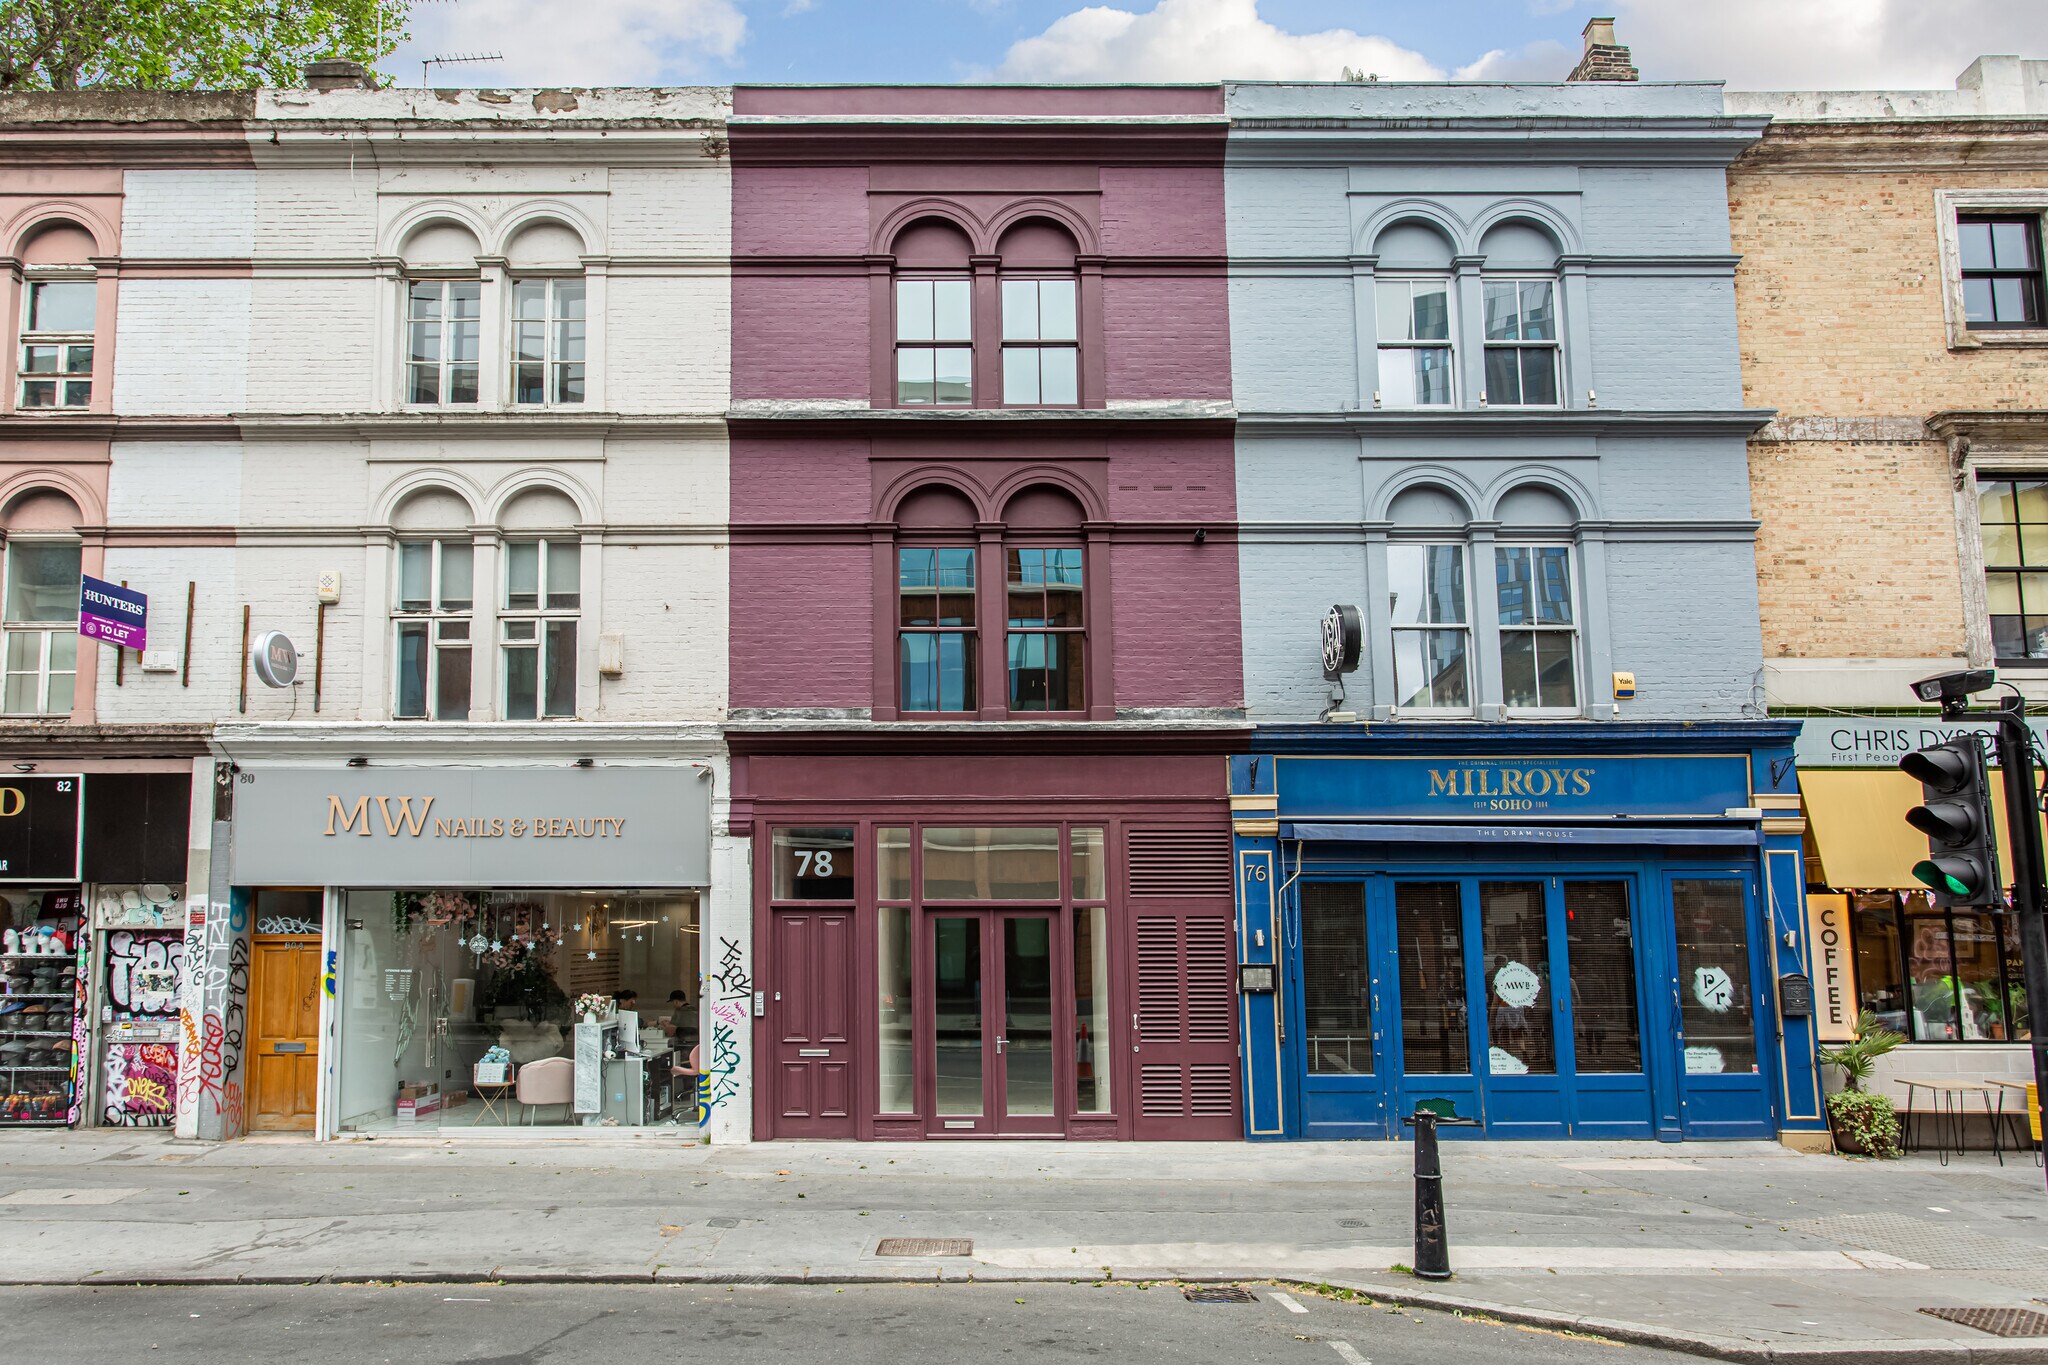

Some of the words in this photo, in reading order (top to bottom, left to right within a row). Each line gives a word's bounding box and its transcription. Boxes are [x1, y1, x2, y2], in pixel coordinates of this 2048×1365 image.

[84, 589, 144, 616] HUNTERS
[100, 624, 112, 634] TO
[114, 628, 129, 639] LET
[1831, 730, 1909, 751] CHRIS
[1919, 730, 1999, 751] DYO
[1831, 752, 1858, 762] First
[1866, 752, 1903, 763] Peop
[57, 781, 72, 792] 82
[240, 773, 255, 785] 80
[1490, 799, 1533, 811] SOHO
[323, 795, 435, 837] MW
[435, 817, 504, 838] NAILS
[509, 817, 528, 838] &
[532, 817, 625, 838] BEAUTY
[1477, 829, 1496, 837] THE
[1503, 829, 1532, 837] DRAM
[1538, 830, 1574, 838] HOUSE
[794, 850, 834, 877] 78
[1246, 864, 1267, 882] 76
[1820, 909, 1842, 1024] COFFEE
